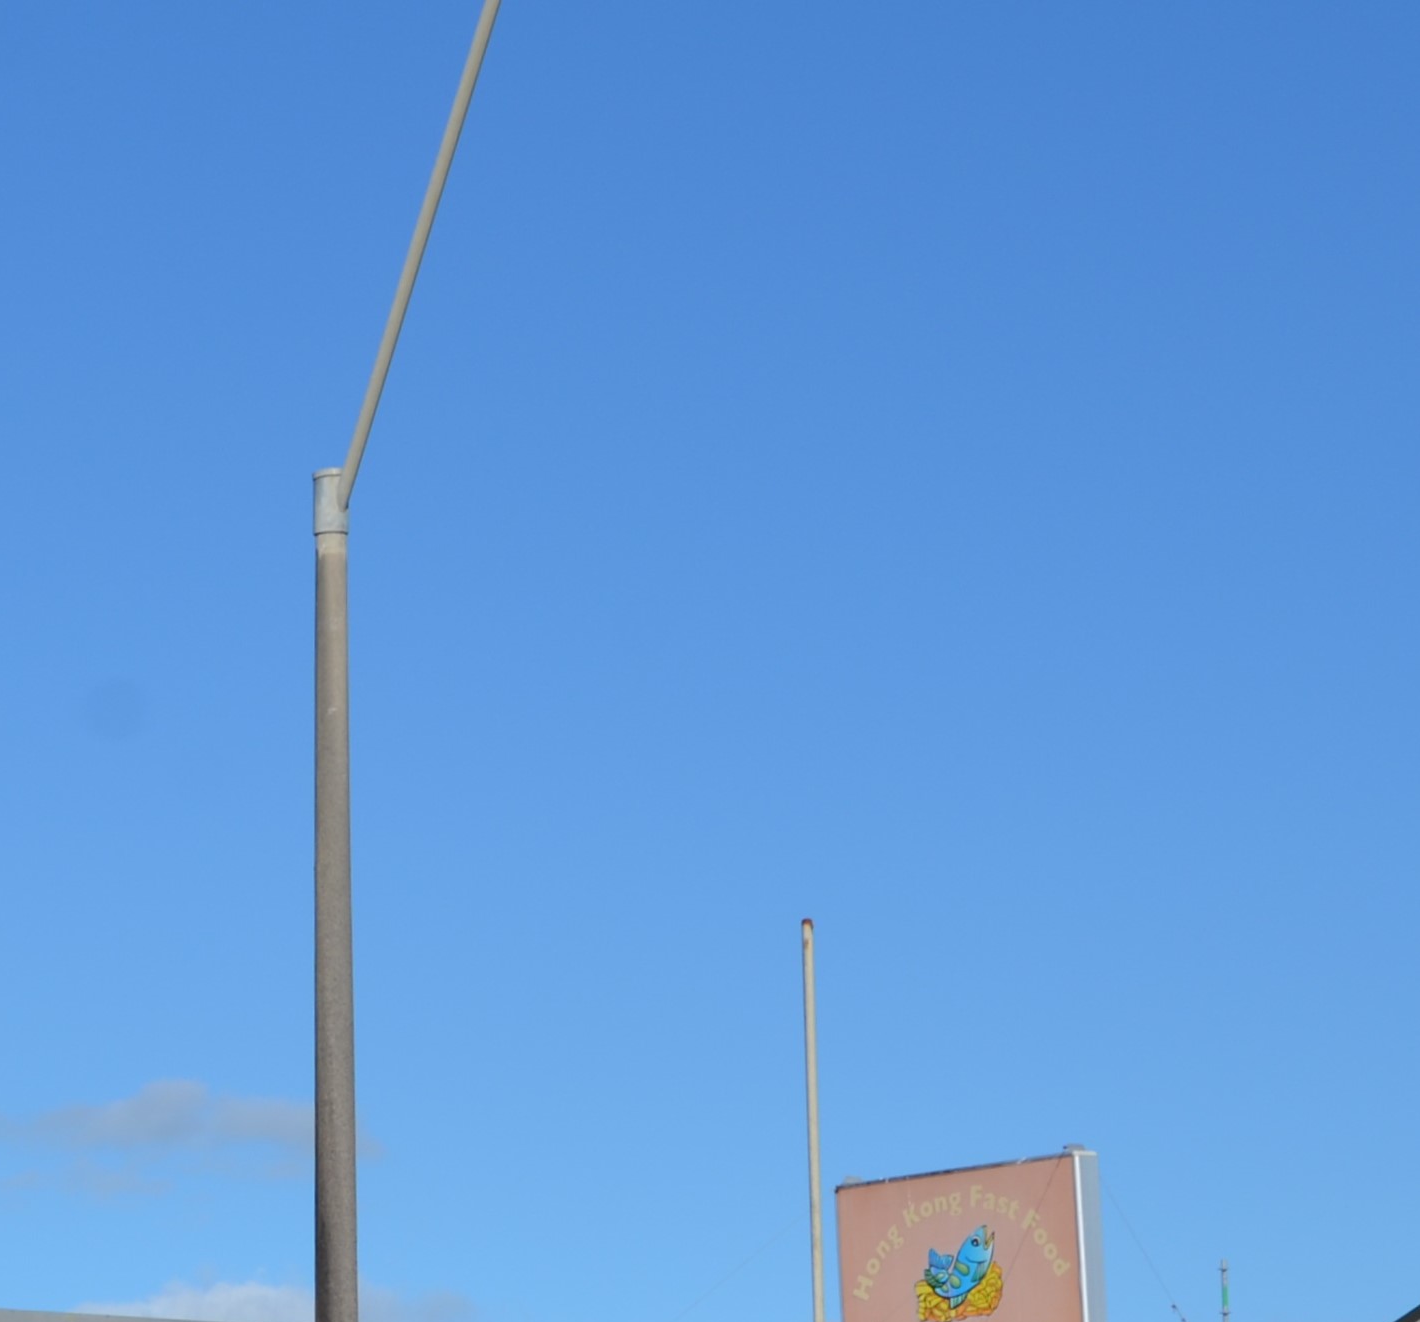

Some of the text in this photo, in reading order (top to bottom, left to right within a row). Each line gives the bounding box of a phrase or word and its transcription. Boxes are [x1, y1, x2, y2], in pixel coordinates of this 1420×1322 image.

[853, 1185, 1071, 1301] Hong Kong Fast Food
